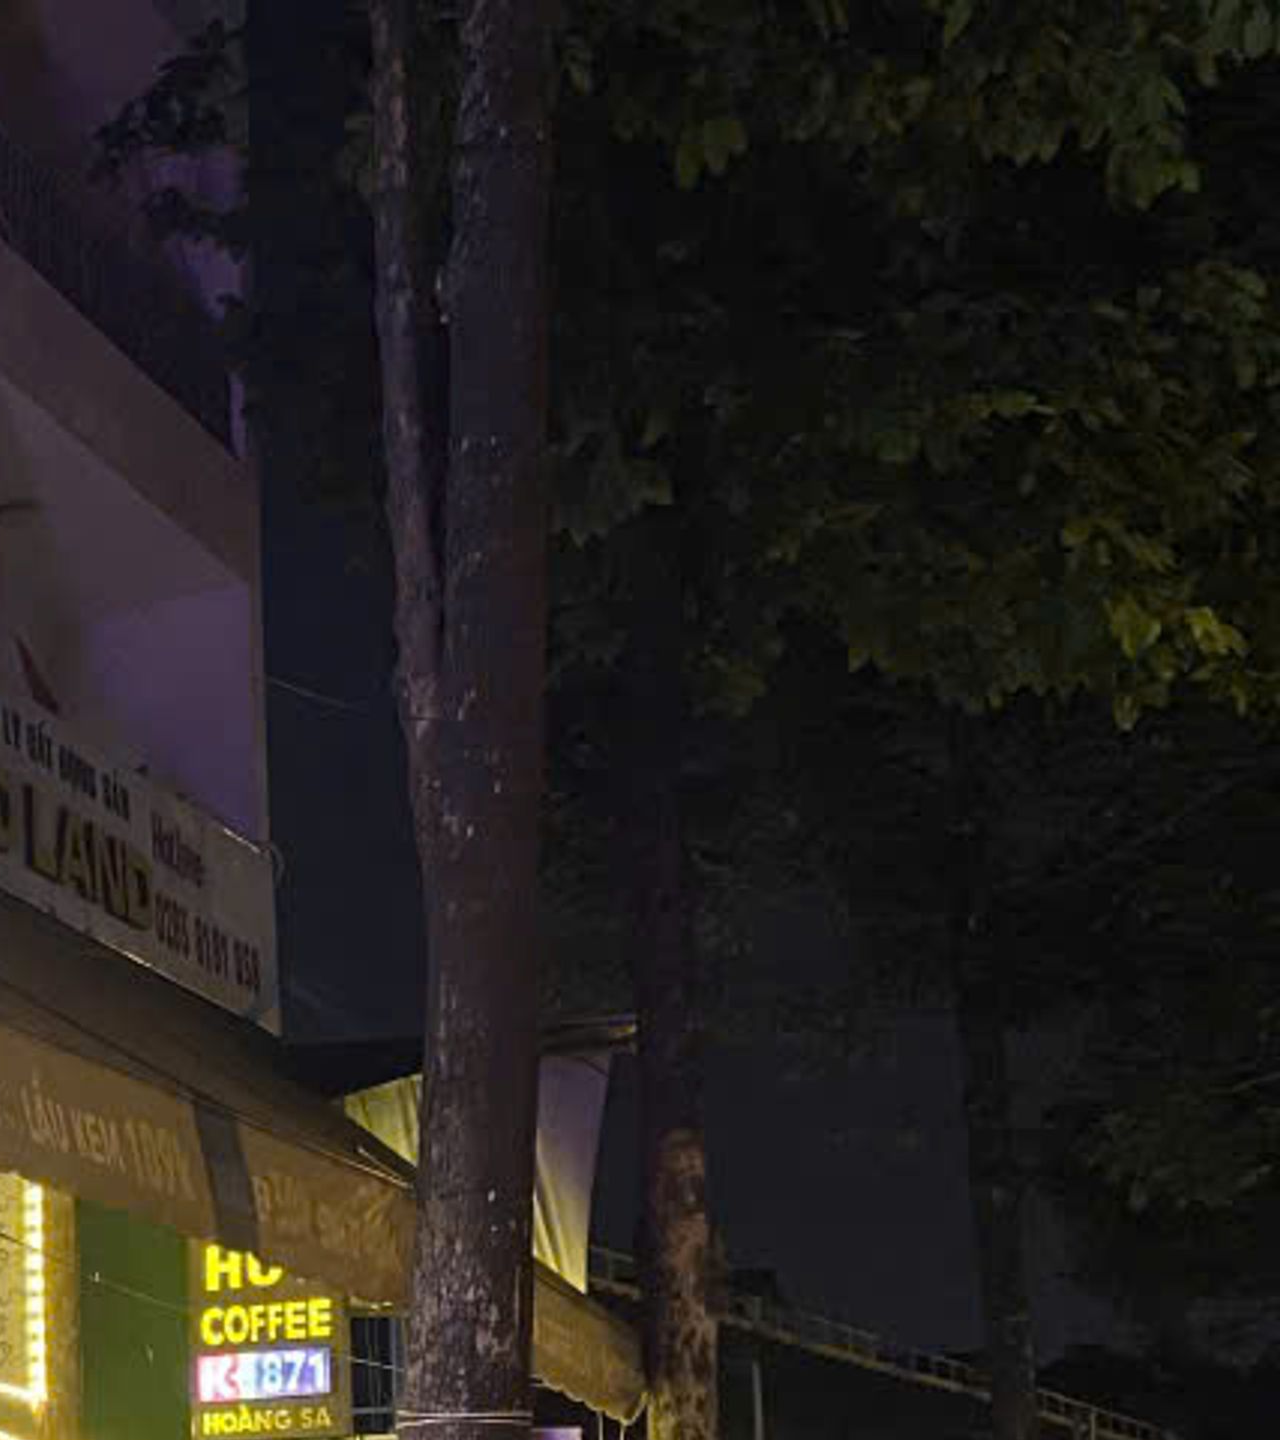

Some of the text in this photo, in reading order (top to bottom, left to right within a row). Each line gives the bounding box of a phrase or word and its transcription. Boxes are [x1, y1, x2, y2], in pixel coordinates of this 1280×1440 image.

[23, 782, 156, 932] LAND
[205, 1244, 287, 1292] HU
[200, 1298, 333, 1346] COFFEE
[202, 1403, 332, 1436] HOÀNG SA
